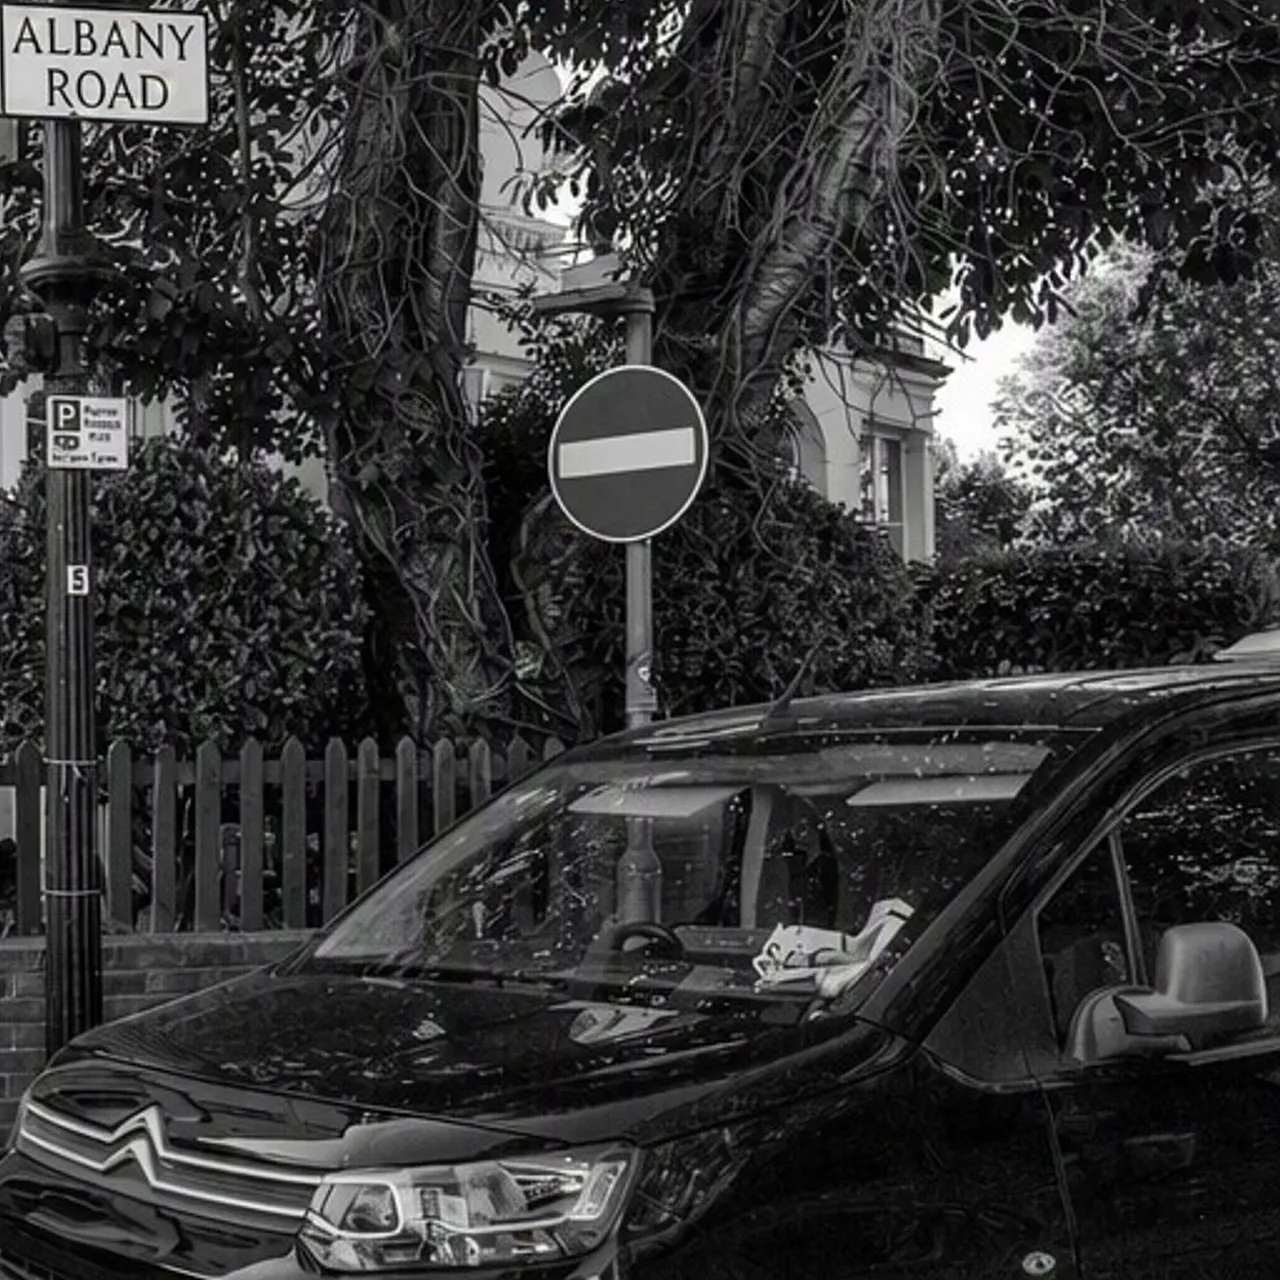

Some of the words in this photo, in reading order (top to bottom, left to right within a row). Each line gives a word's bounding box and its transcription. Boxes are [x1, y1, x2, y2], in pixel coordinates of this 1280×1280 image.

[12, 16, 195, 61] ALBANY
[47, 68, 171, 111] ROAD
[58, 403, 77, 429] P
